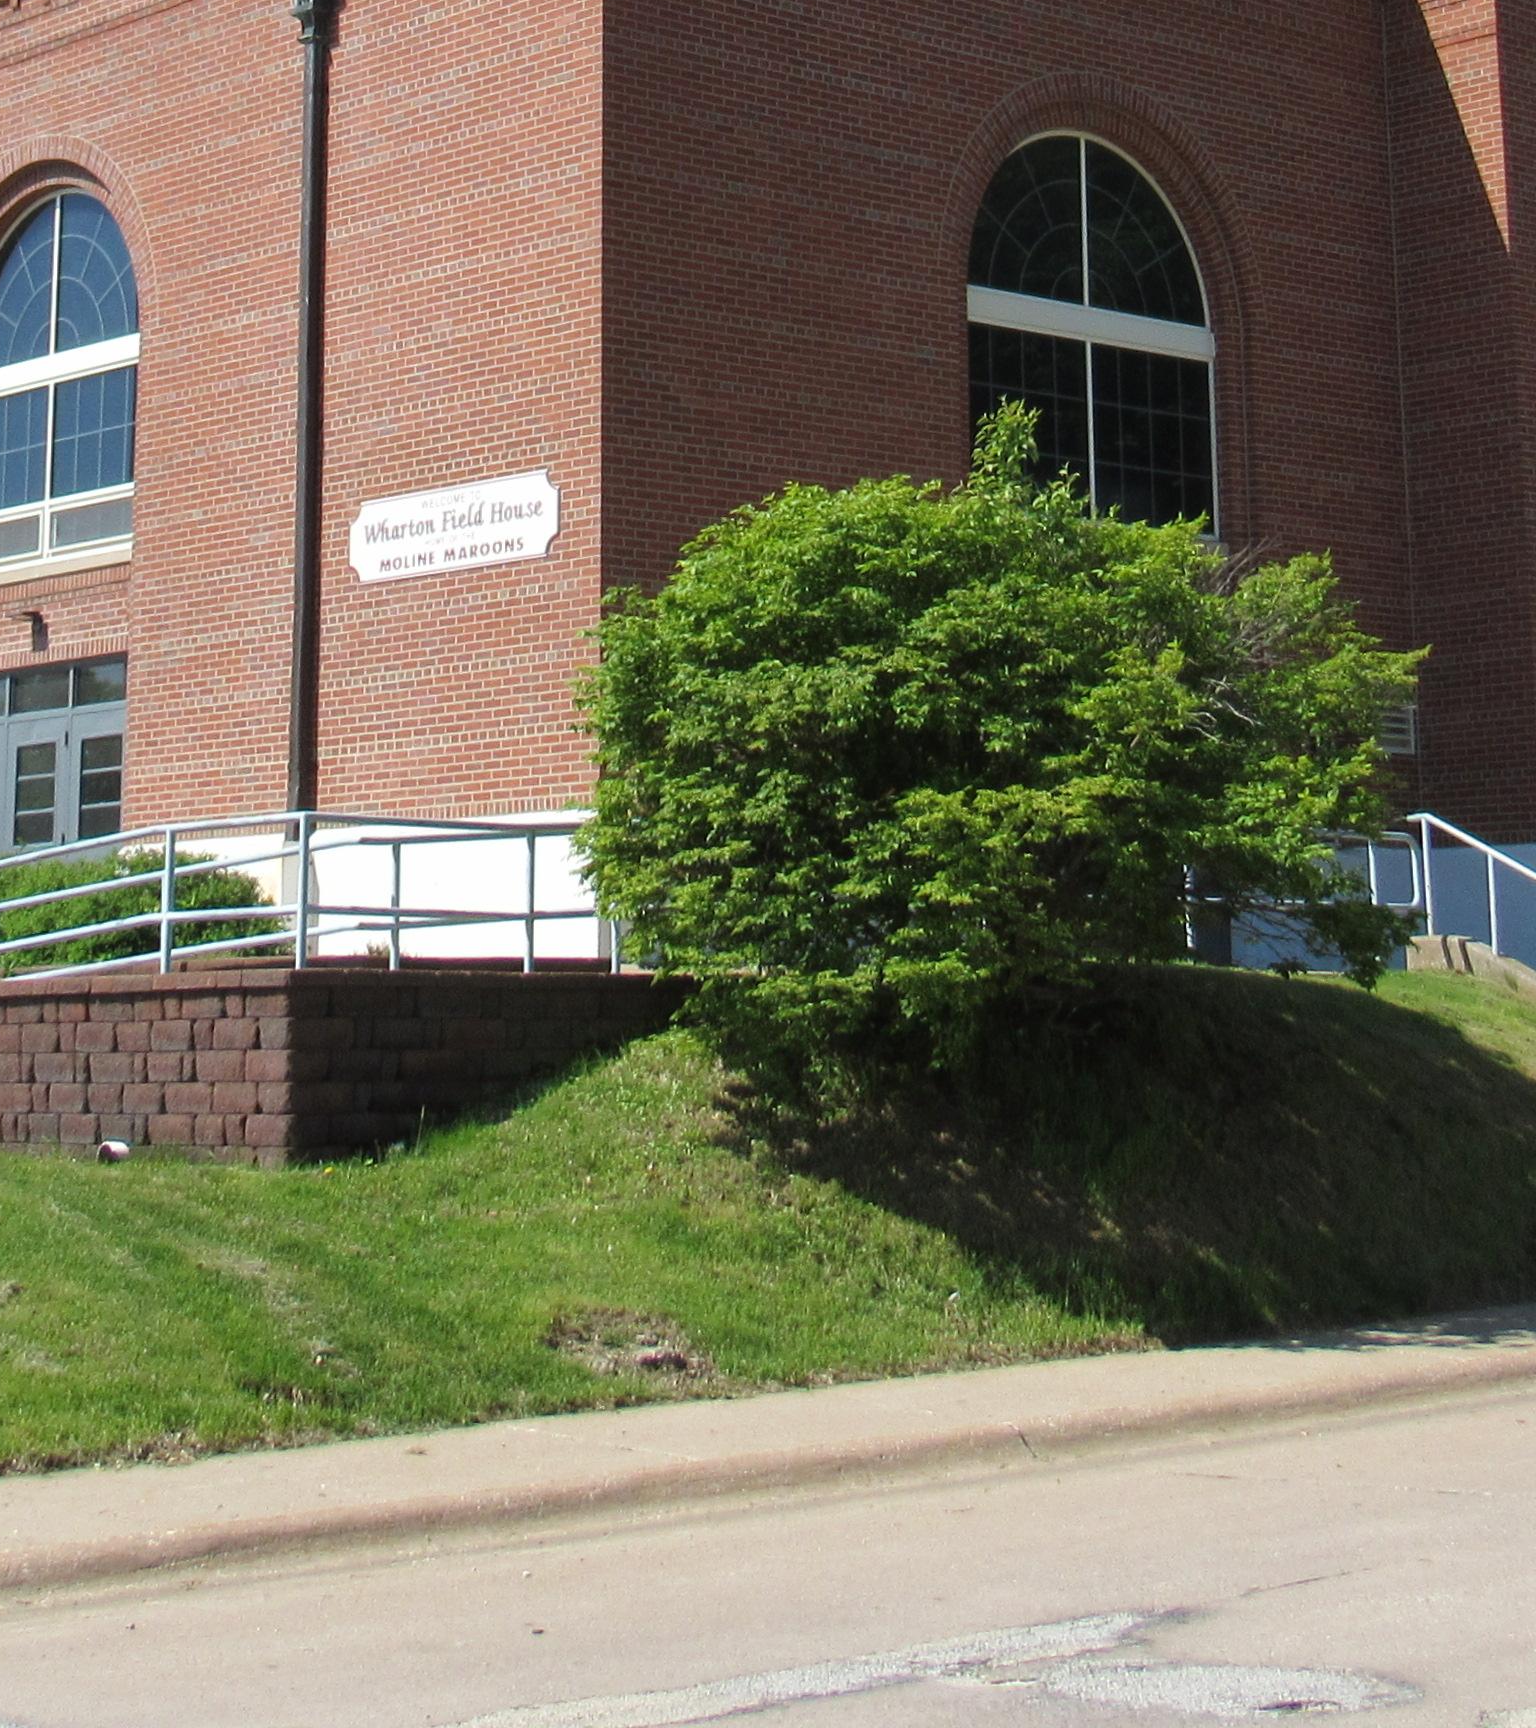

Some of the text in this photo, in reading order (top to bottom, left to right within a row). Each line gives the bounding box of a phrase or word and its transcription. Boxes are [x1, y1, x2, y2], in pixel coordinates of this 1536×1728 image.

[364, 500, 543, 544] Wharton Field House
[379, 537, 524, 572] MOLINE MAROONS
